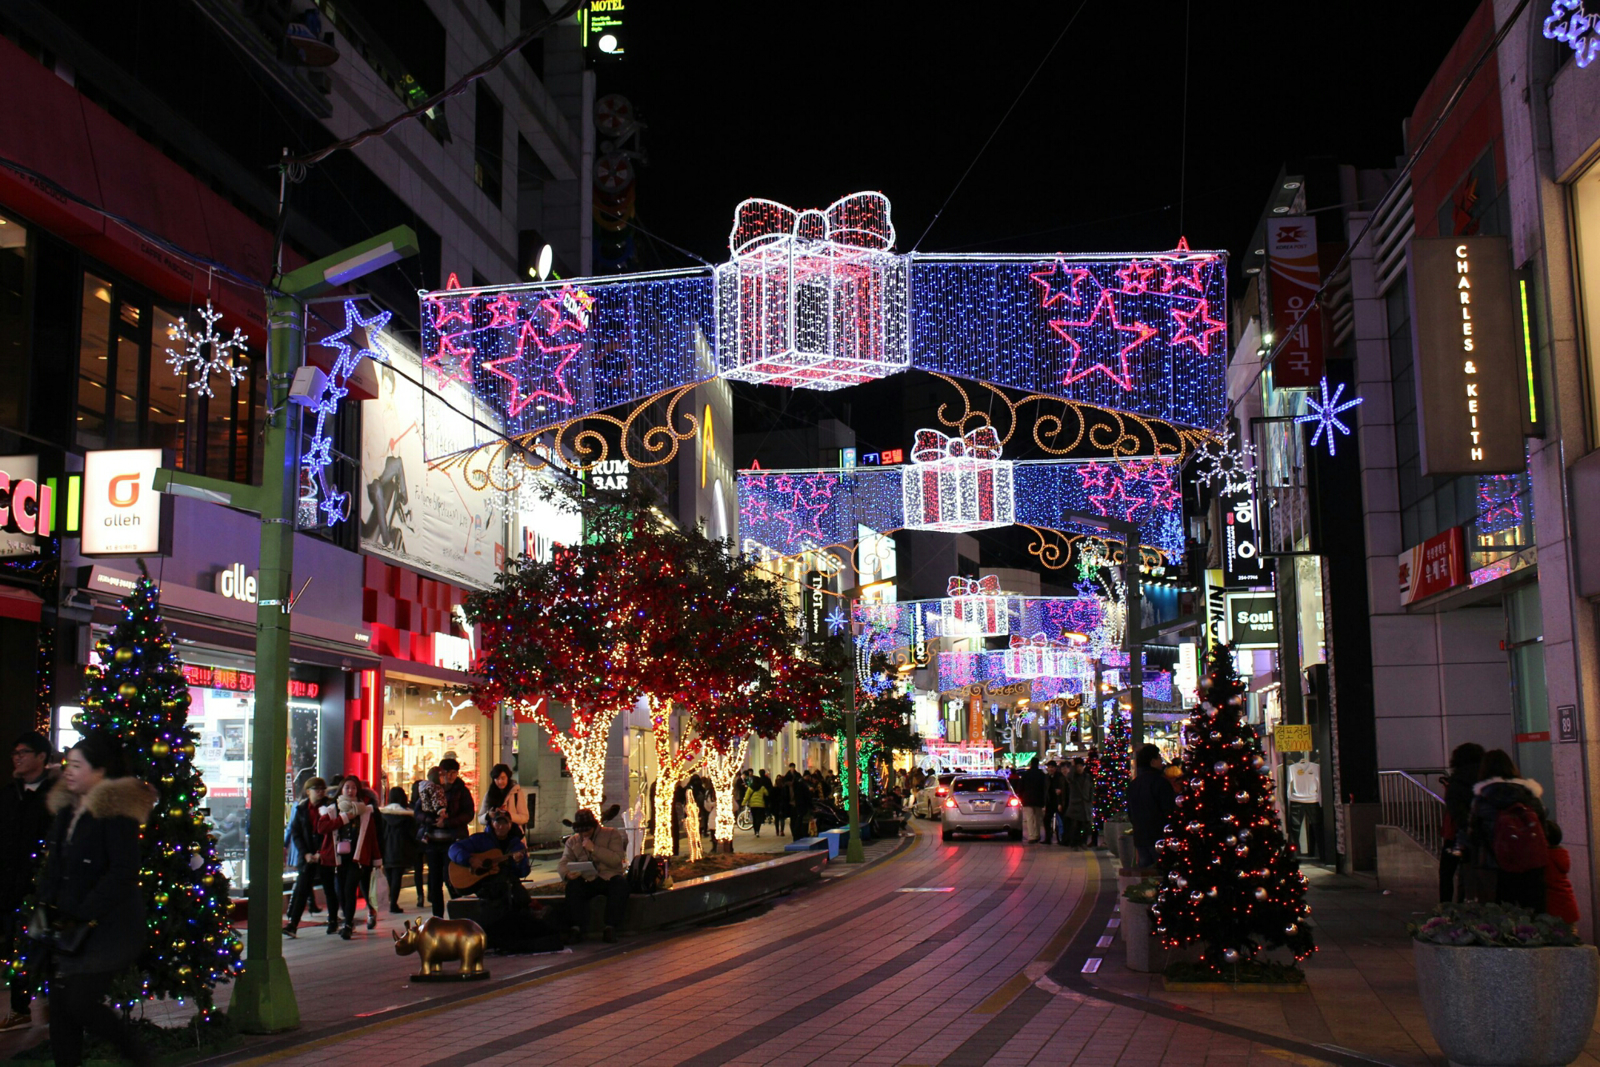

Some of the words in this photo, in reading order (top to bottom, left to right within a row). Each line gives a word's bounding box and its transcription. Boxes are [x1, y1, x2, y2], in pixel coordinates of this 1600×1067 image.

[591, 0, 624, 12] MOTEL
[1455, 245, 1474, 352] CHARLES
[1284, 296, 1311, 376] 우체국
[1464, 361, 1476, 374] &
[1466, 384, 1482, 461] KEITH
[881, 448, 903, 465] 모텔
[591, 459, 630, 475] RUM
[592, 475, 628, 490] BAR
[104, 513, 141, 527] olleh
[1425, 557, 1448, 583] 우체국
[221, 563, 258, 604] olle
[812, 574, 823, 610] TNGT
[1208, 585, 1227, 642] NIKO
[1237, 610, 1273, 624] Soul
[1250, 623, 1274, 632] ways
[1562, 717, 1571, 733] 89
[1275, 726, 1311, 741] 점포정리
